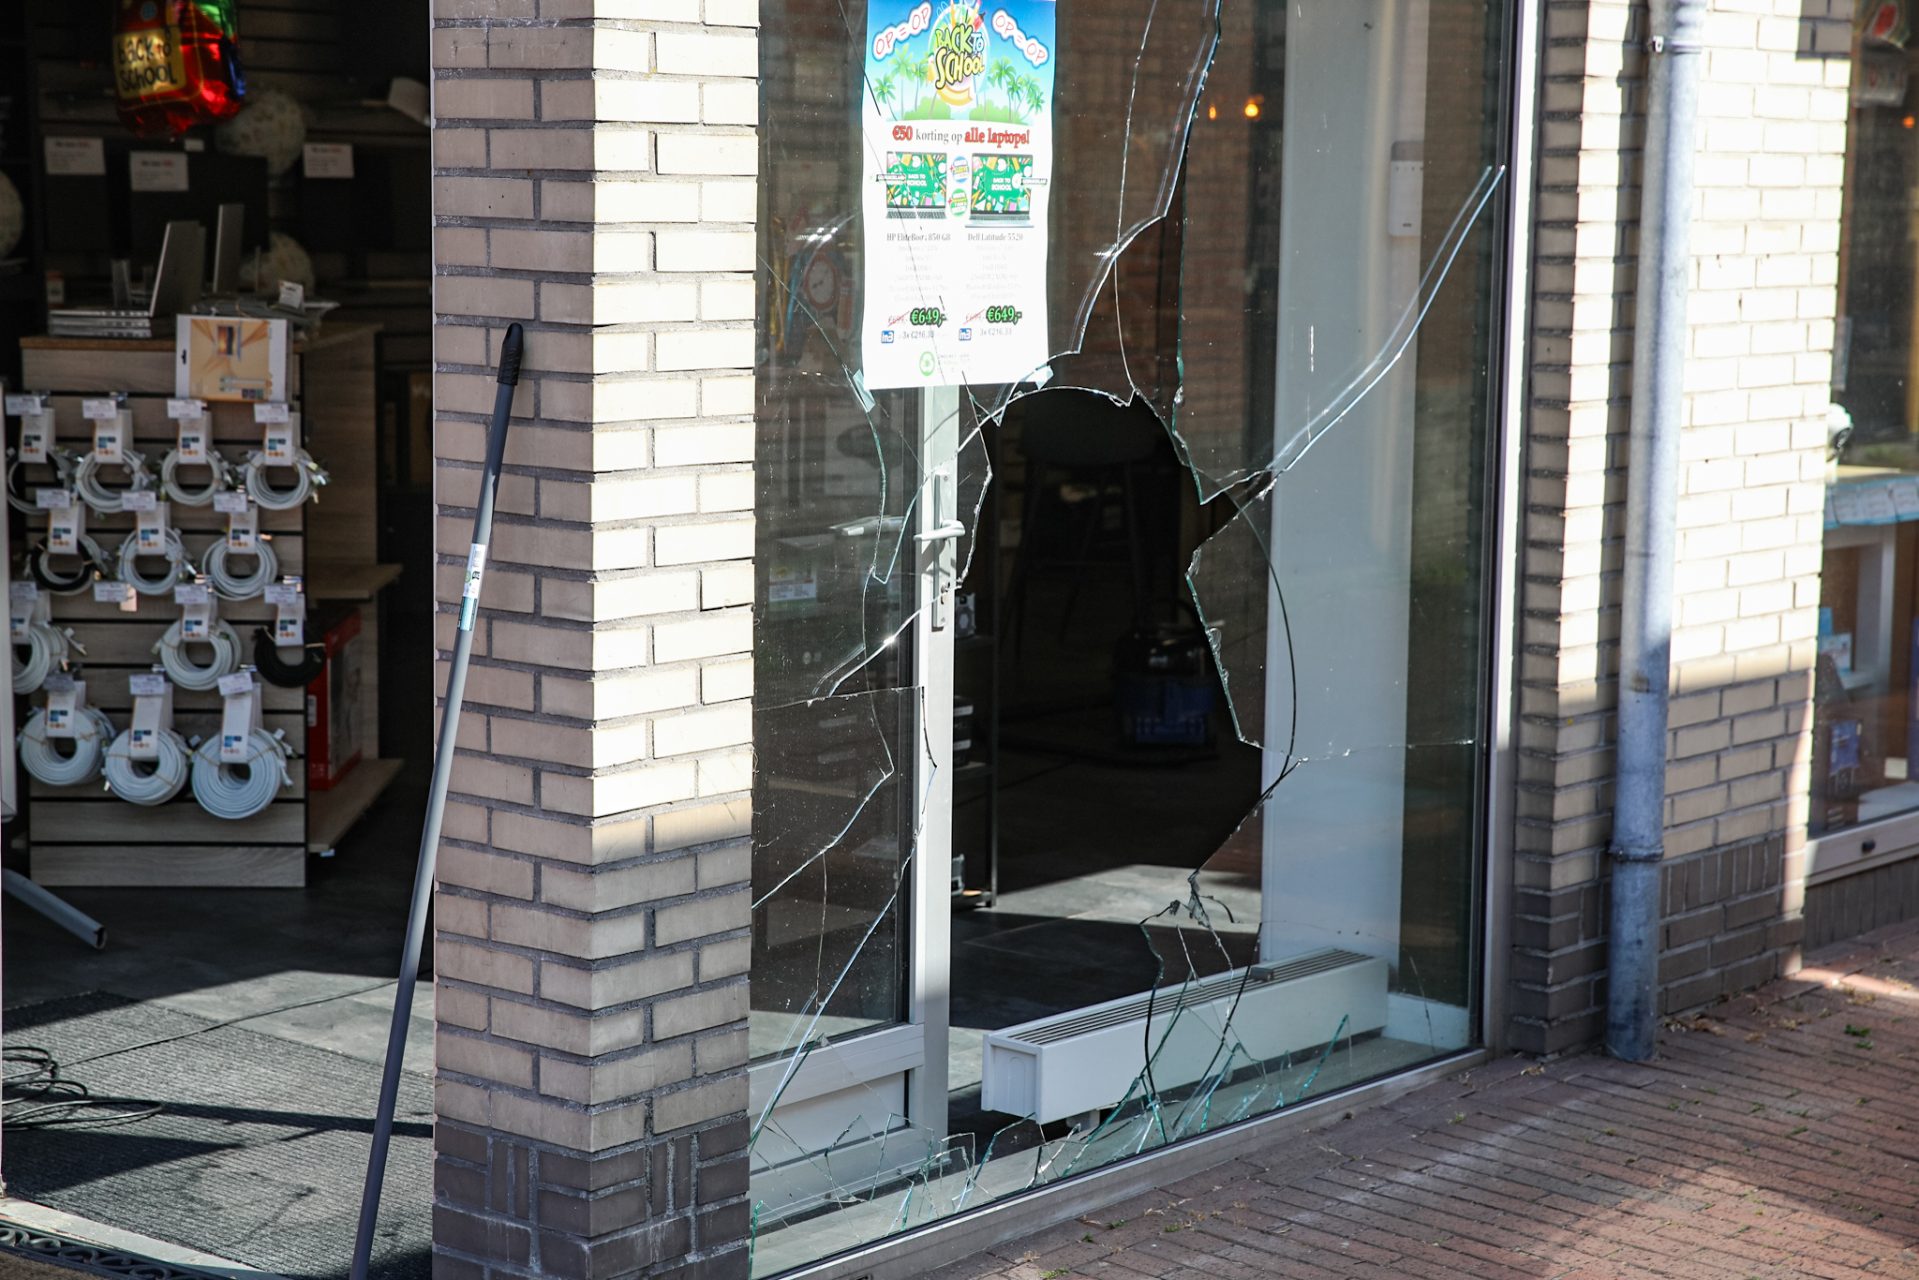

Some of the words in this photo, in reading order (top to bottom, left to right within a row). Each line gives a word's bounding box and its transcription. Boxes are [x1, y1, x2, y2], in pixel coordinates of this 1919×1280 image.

[935, 24, 973, 53] BACK
[972, 32, 985, 52] TO
[935, 47, 985, 90] SCHOOL
[892, 125, 913, 141] €50
[915, 129, 949, 144] korting
[951, 132, 962, 146] op
[964, 128, 985, 143] alle
[988, 128, 1030, 148] laptops!
